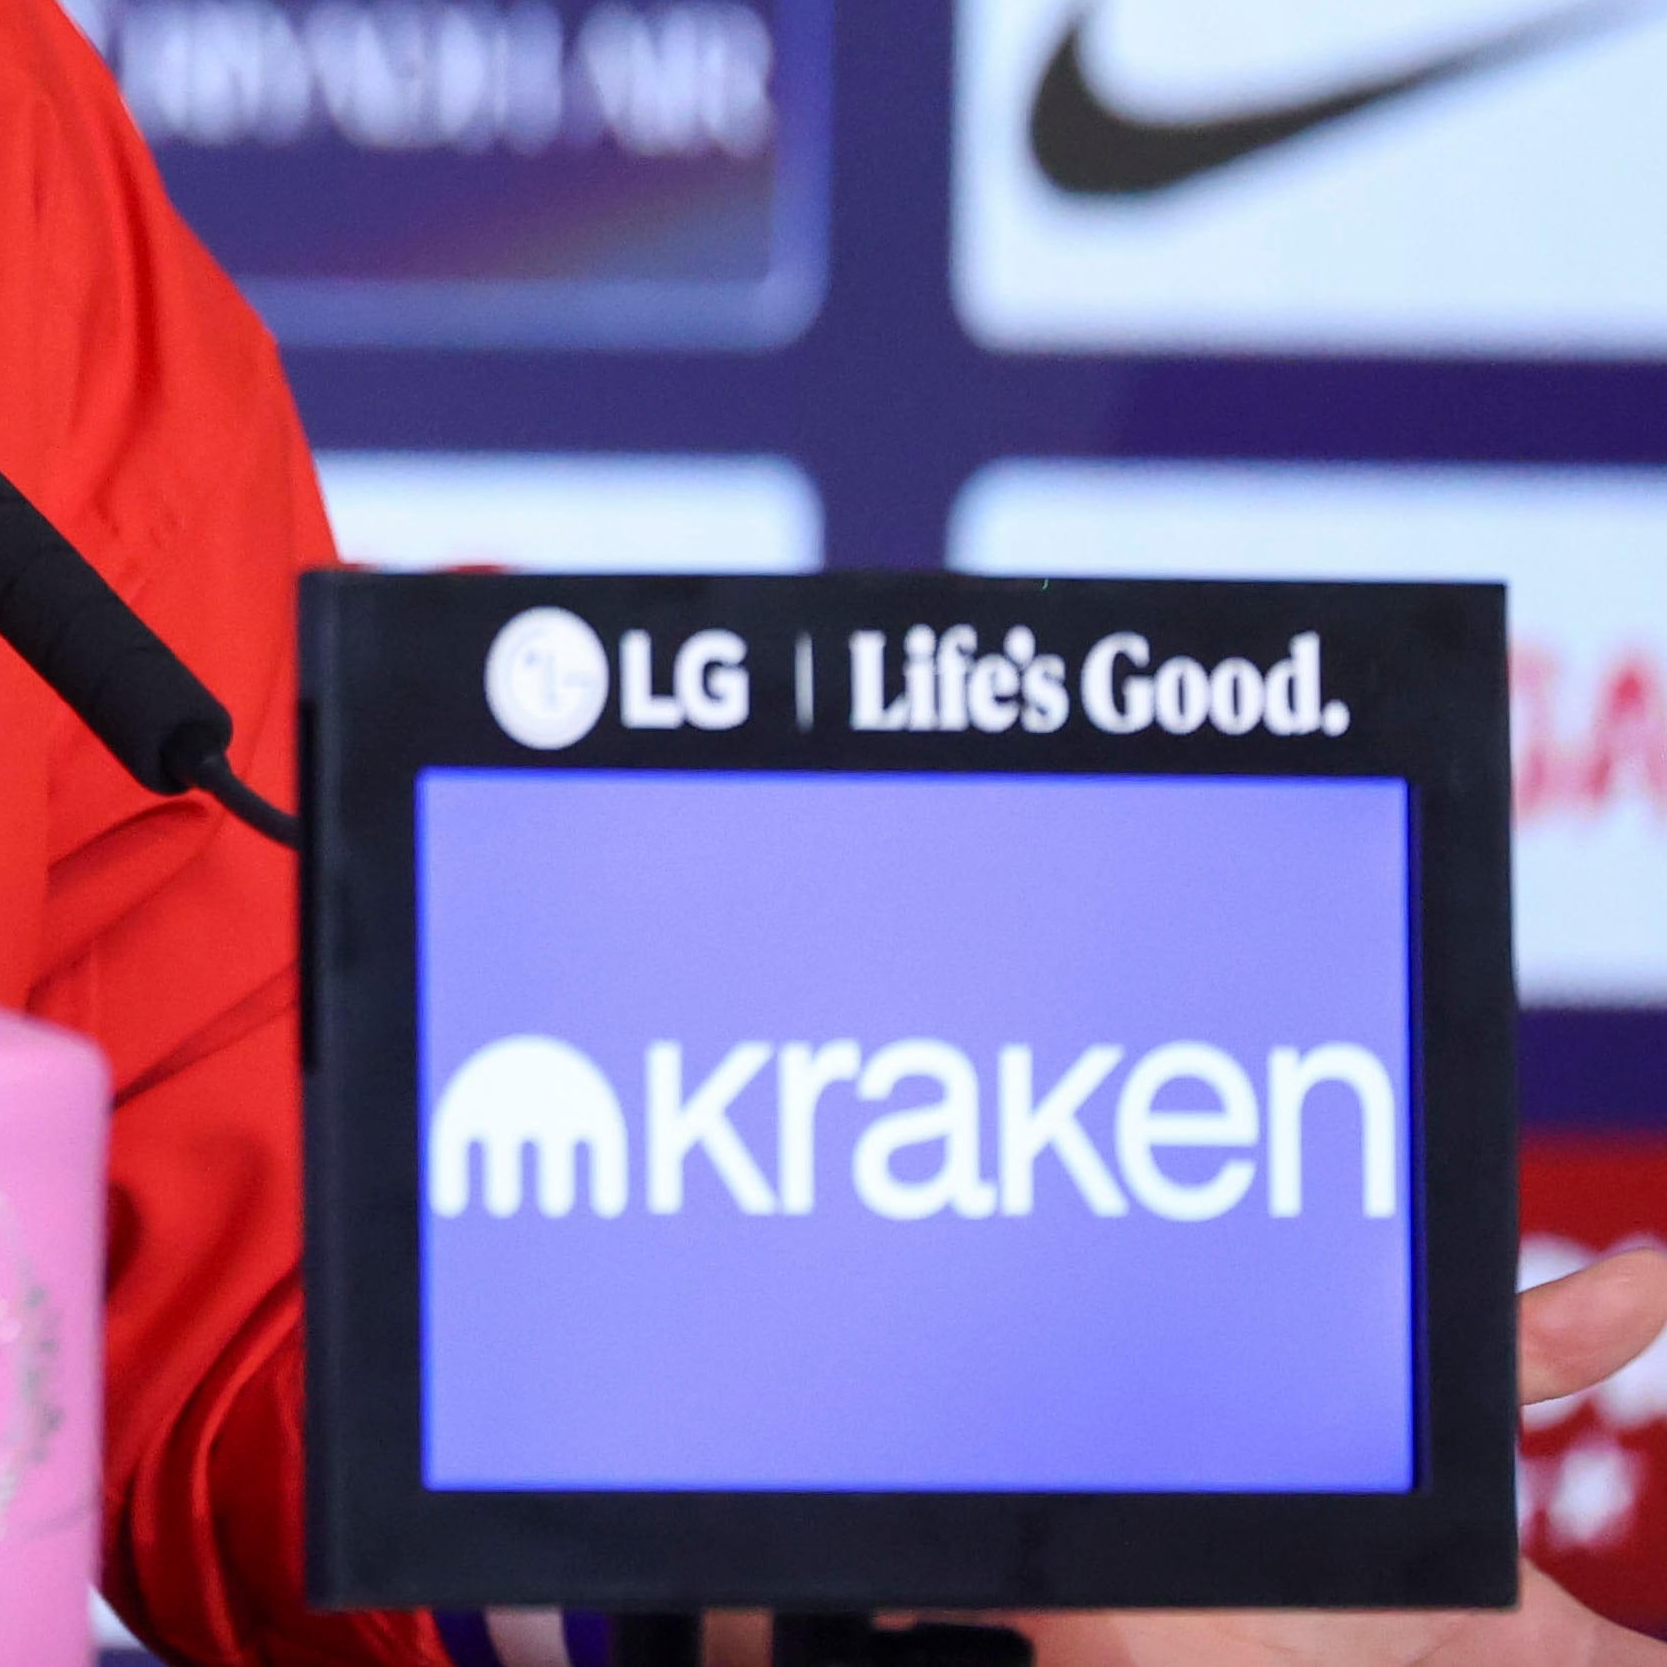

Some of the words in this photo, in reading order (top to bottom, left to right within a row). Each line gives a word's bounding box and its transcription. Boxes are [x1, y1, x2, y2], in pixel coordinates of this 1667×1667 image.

[620, 630, 749, 730] LG
[849, 624, 1068, 732] Life's
[1080, 631, 1351, 736] Good.
[644, 1036, 1397, 1221] kraken
